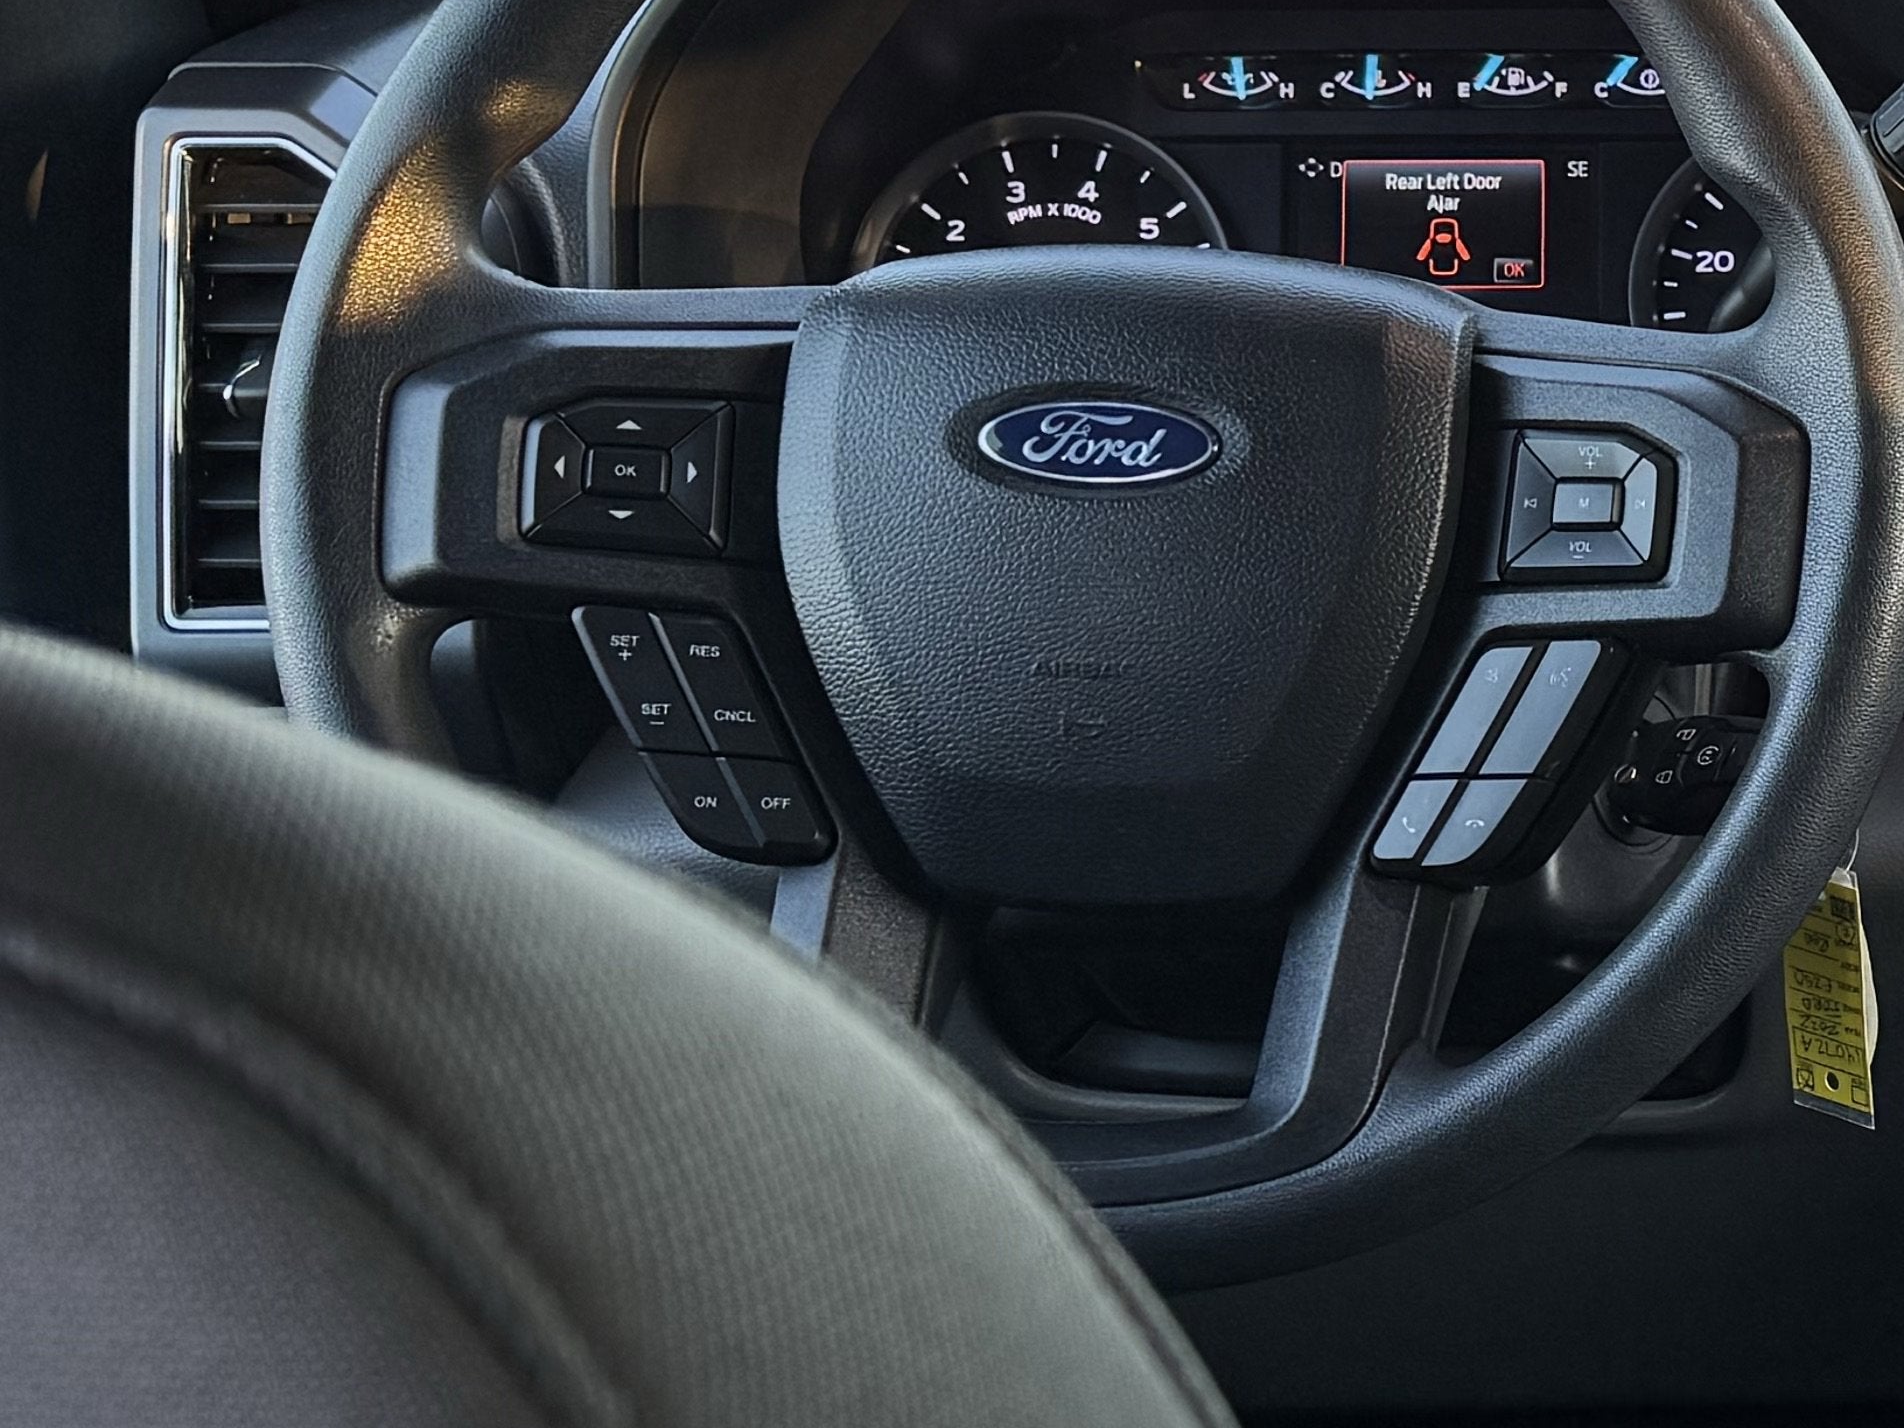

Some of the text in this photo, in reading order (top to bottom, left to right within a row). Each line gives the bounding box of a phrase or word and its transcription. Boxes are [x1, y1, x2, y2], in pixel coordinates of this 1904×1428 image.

[1183, 82, 1196, 100] L
[1279, 82, 1295, 99] H
[1319, 82, 1336, 99] C
[1416, 81, 1432, 99] H
[1457, 81, 1471, 98] E
[1555, 82, 1568, 98] F
[1593, 81, 1609, 99] C
[1567, 160, 1589, 178] SE
[1385, 172, 1503, 191] Rear Left Door
[1005, 180, 1026, 203] 3
[1077, 180, 1100, 203] 4
[1426, 194, 1461, 214] Ajar
[1006, 203, 1043, 227] RPM
[1063, 203, 1102, 226] 1000
[945, 219, 966, 242] 2
[1139, 217, 1160, 240] 5
[1695, 250, 1735, 273] 20
[1503, 263, 1526, 278] OK
[1022, 410, 1168, 469] Ford
[1578, 445, 1604, 458] VOL
[614, 464, 637, 477] OK
[1569, 541, 1592, 554] VOL
[609, 634, 640, 648] SET
[689, 644, 721, 658] RES
[641, 703, 671, 716] SET
[713, 709, 756, 723] CNCL
[694, 796, 717, 808] ON
[760, 796, 791, 810] OFF
